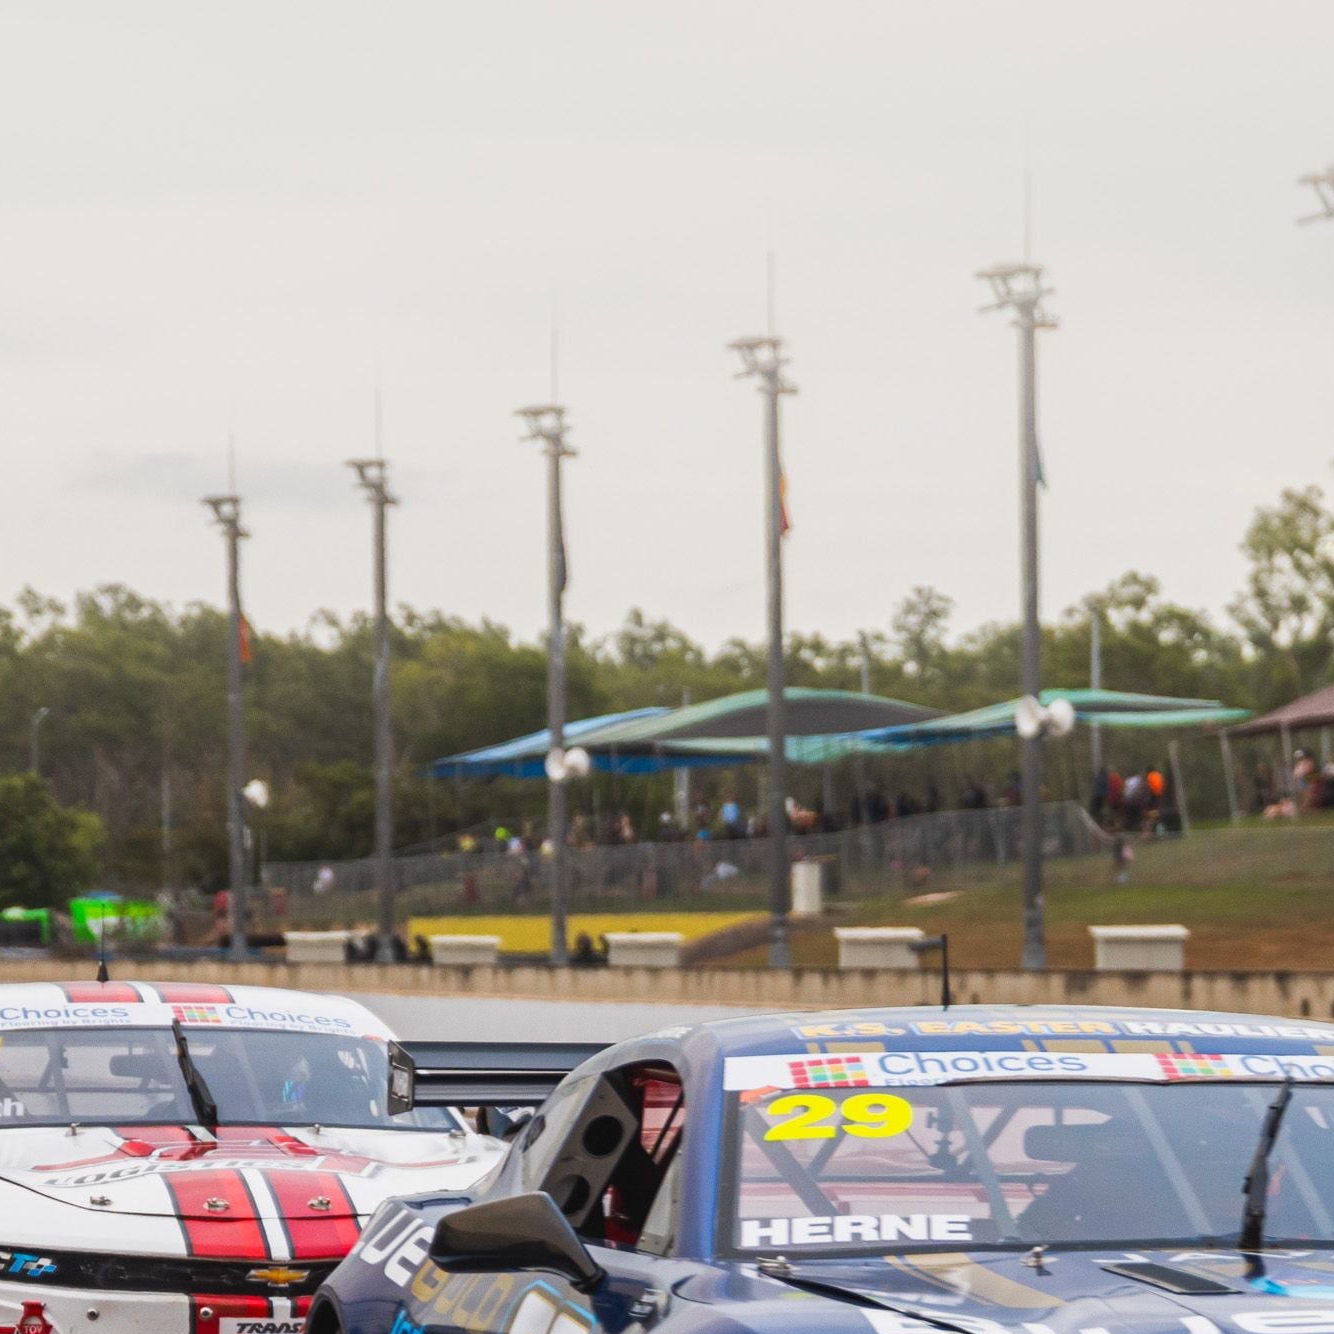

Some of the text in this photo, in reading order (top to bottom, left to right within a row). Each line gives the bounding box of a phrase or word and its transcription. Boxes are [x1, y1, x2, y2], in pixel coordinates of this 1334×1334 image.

[0, 1007, 129, 1020] Choices
[225, 1006, 351, 1028] Choices
[795, 1022, 907, 1040] K.S.
[909, 1021, 1118, 1038] EASTER
[878, 1052, 1088, 1075] Choices
[763, 1093, 913, 1141] 29
[741, 1214, 973, 1248] HERNE
[235, 1322, 306, 1334] TRANS
